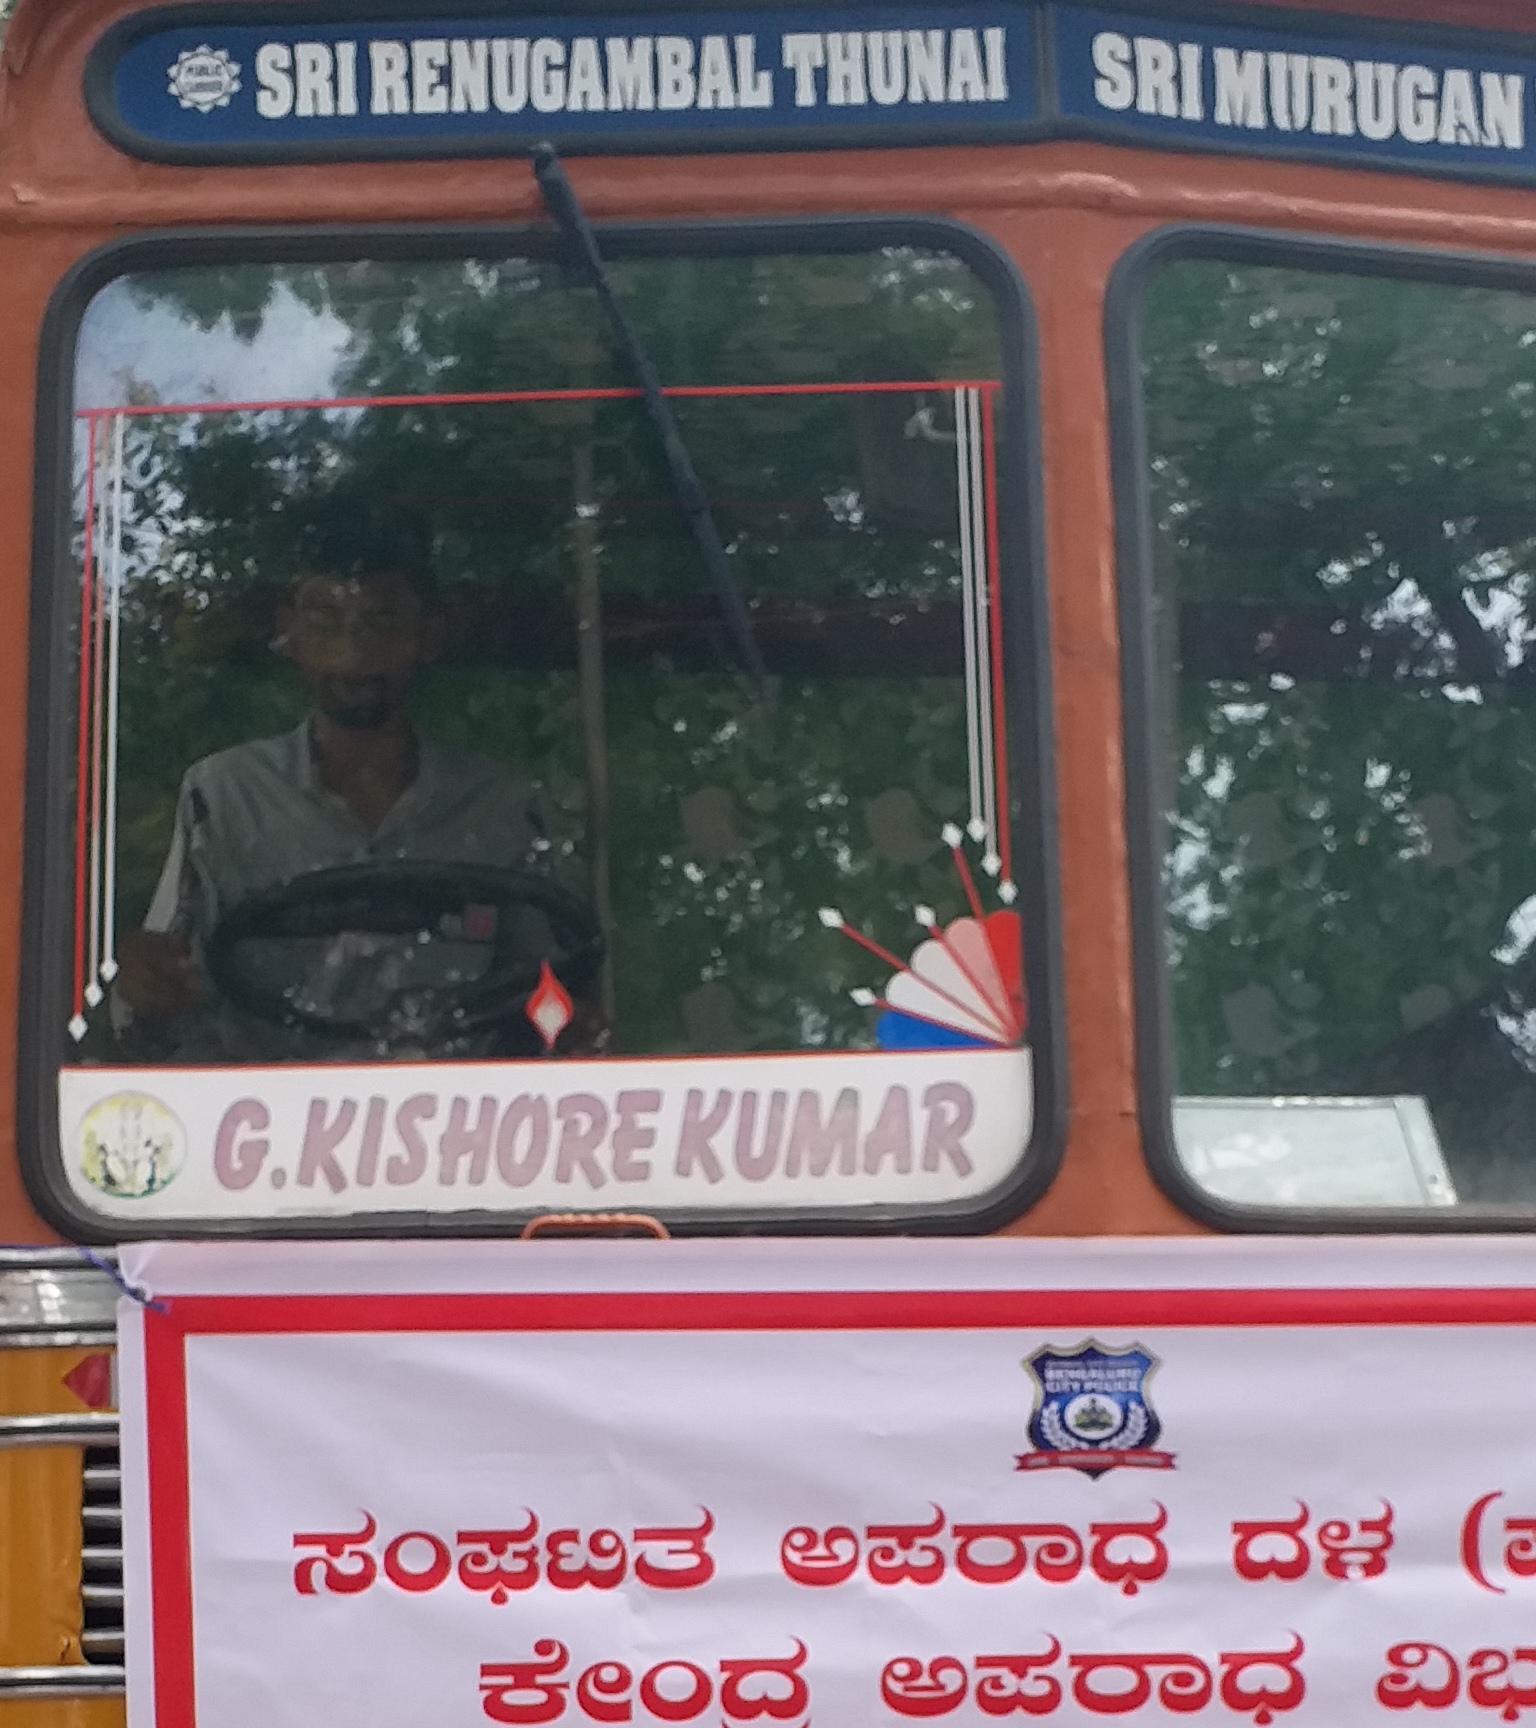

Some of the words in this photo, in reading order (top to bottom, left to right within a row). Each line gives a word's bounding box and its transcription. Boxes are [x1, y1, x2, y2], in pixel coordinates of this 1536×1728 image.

[256, 42, 357, 118] SRI
[370, 35, 772, 114] RENUGAMBAL
[782, 27, 1007, 106] THUNAI
[1092, 33, 1203, 121] SRI
[1214, 48, 1523, 148] MURUGAN
[673, 1081, 975, 1182] KUMAR
[292, 1506, 716, 1606] ಸಂಘಟಿತ
[780, 1501, 1170, 1597] ಅಪರಾಧ
[1231, 1500, 1394, 1583] ದಳ
[879, 1632, 1307, 1727] ಅಪರಾಧ
